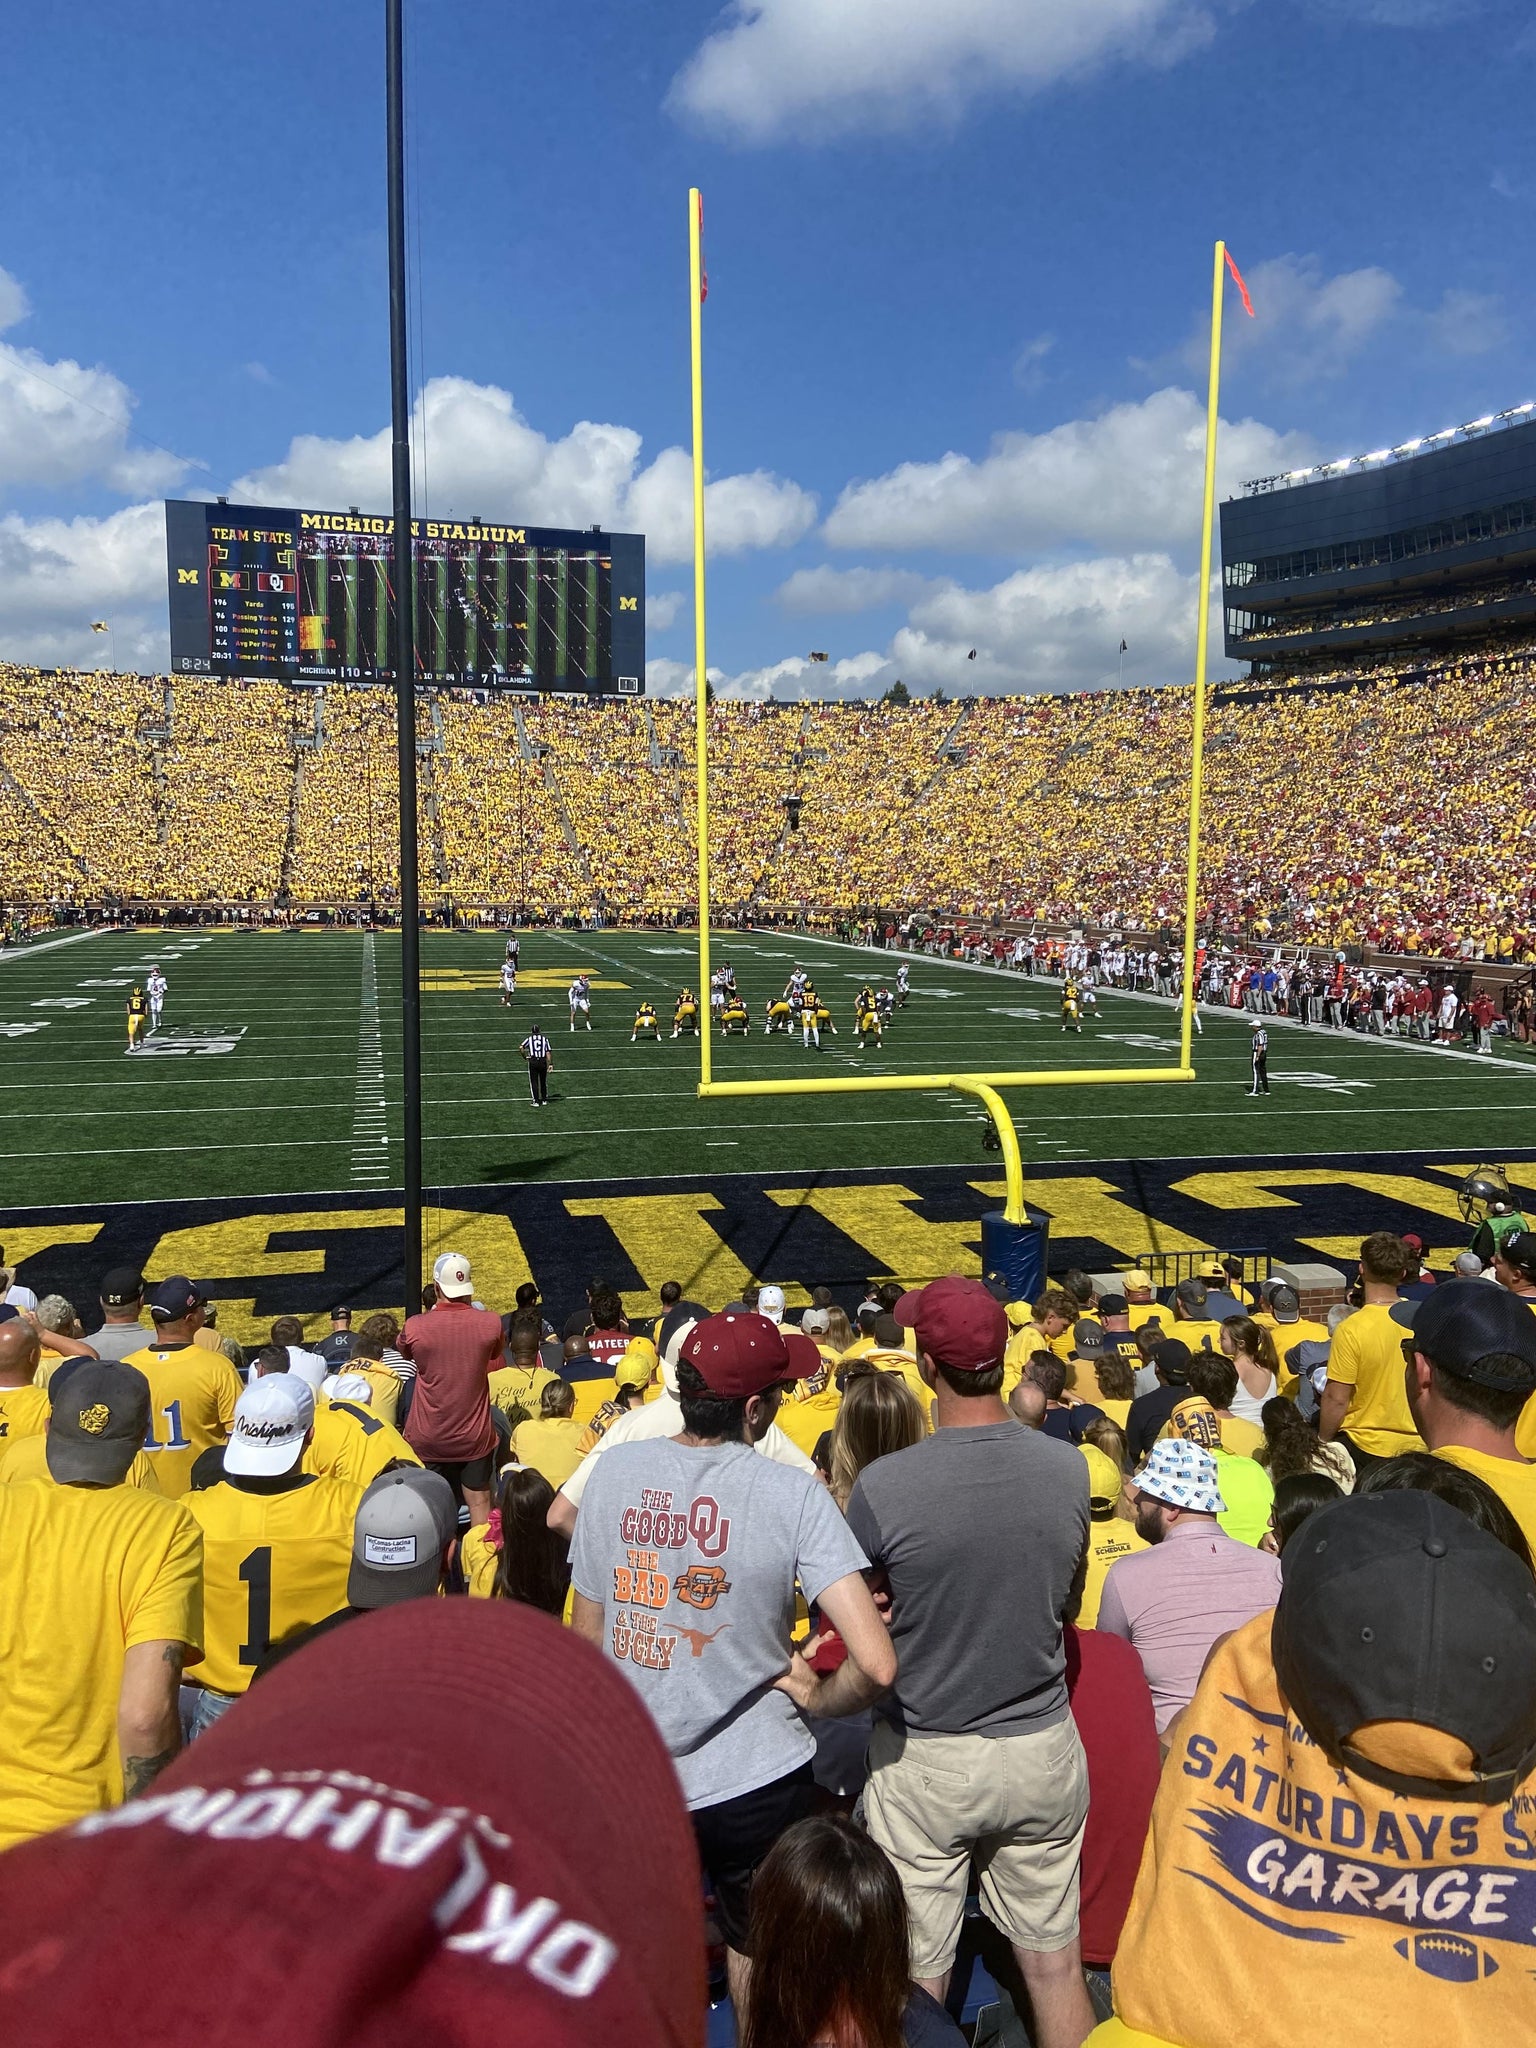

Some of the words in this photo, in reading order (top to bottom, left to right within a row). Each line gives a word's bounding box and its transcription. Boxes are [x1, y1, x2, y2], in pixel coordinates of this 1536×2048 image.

[211, 527, 249, 541] TEAM
[253, 530, 292, 544] STATS
[301, 513, 420, 536] MICHIGAN
[426, 521, 526, 544] STADIUM
[177, 568, 199, 584] M
[213, 598, 228, 606] 196
[245, 600, 264, 608] Yards
[619, 596, 637, 611] M
[215, 611, 226, 619] 96
[232, 613, 258, 622] Passing
[282, 615, 295, 624] 129
[214, 625, 228, 633] 100
[259, 627, 279, 636] Yards
[215, 638, 228, 646] 5.4
[248, 640, 260, 648] Per
[211, 651, 232, 660] 20:31
[181, 657, 211, 671] 8:24
[299, 666, 337, 676] MICHIGAN
[346, 667, 361, 678] 10
[481, 673, 489, 684] 7
[680, 993, 694, 1002] 77
[803, 995, 816, 1007] 19
[1065, 988, 1078, 999] 42
[132, 997, 141, 1010] 6
[868, 997, 876, 1009] 5
[534, 1040, 542, 1050] C
[500, 1386, 527, 1399] Stay
[236, 1414, 294, 1445] Michigan
[641, 1488, 674, 1510] THE
[620, 1505, 688, 1549] GOOD
[687, 1494, 731, 1559] OU
[371, 1544, 406, 1552] Construction
[1095, 1544, 1132, 1556] SCHEDULE
[627, 1548, 660, 1571] THE
[613, 1565, 670, 1610] BAD
[238, 1546, 271, 1666] 1
[617, 1609, 629, 1627] &
[630, 1609, 659, 1635] THE
[612, 1625, 678, 1670] UGLY
[1182, 1733, 1480, 1861] SATURDAYS
[1246, 1838, 1520, 1925] GARAGE
[75, 1784, 618, 1998] OKLAHOM
